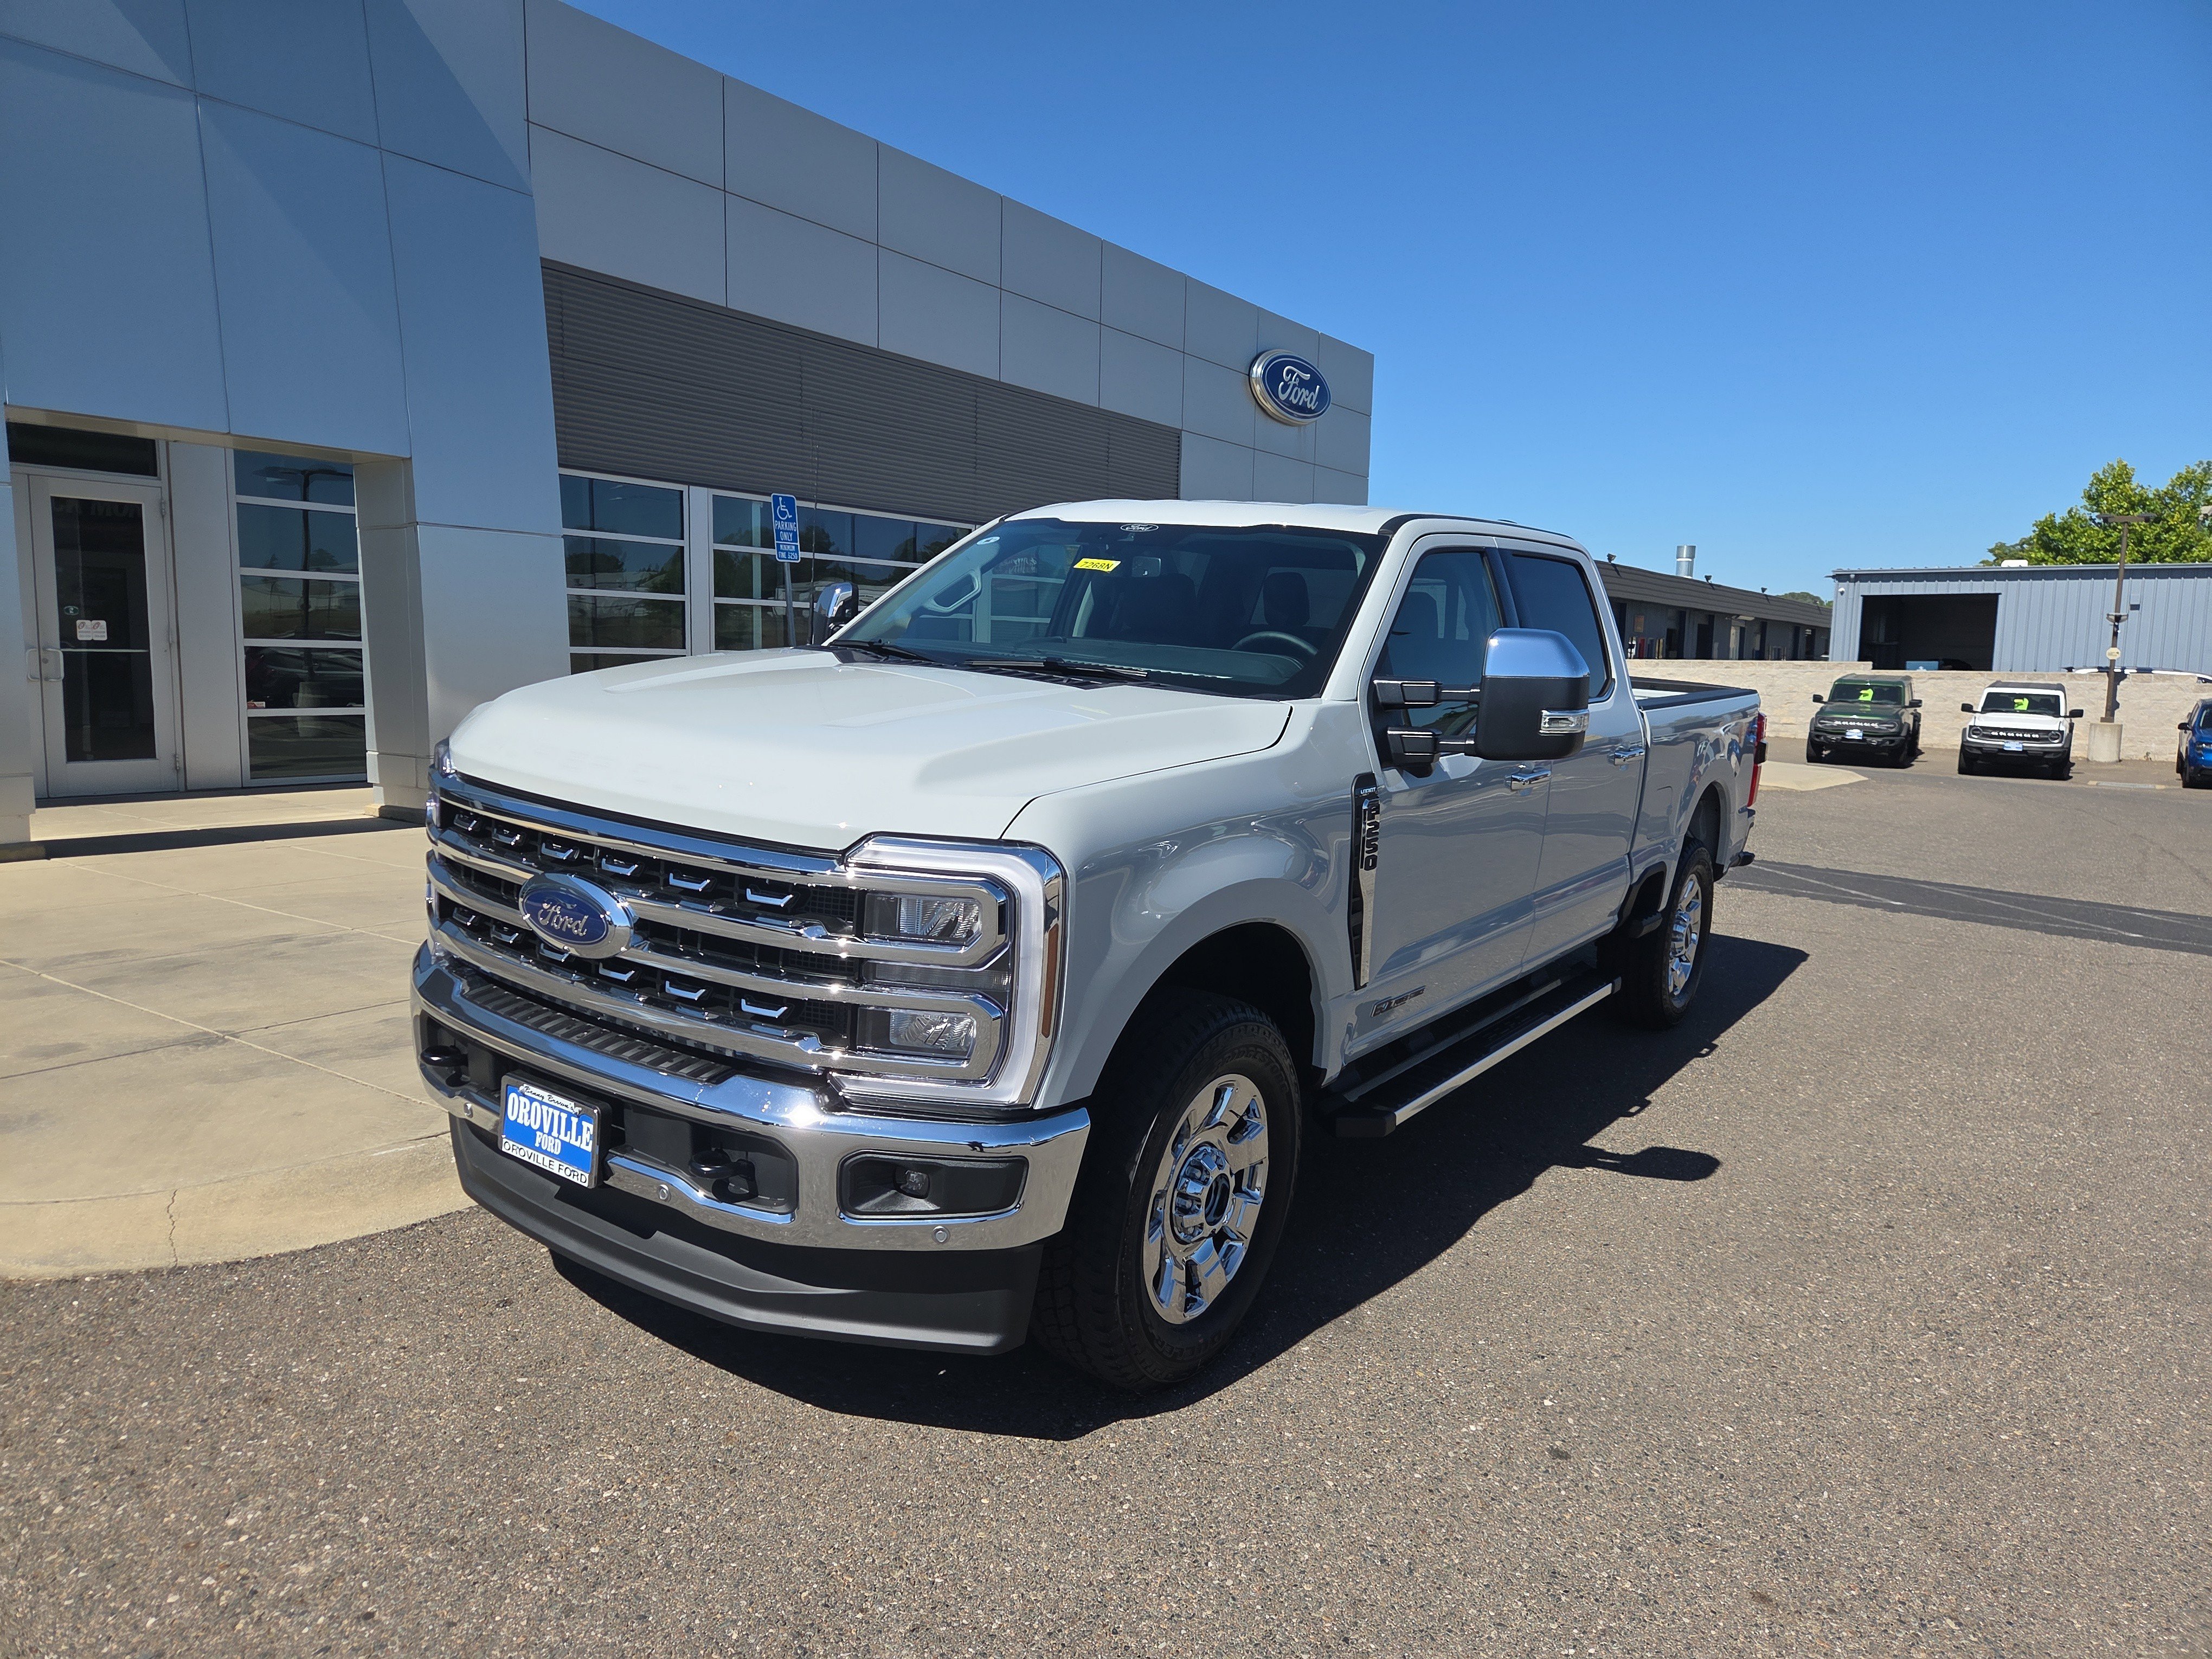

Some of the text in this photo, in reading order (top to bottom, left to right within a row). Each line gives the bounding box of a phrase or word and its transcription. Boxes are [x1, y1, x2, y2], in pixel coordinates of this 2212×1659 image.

[1278, 366, 1320, 409] Ford
[775, 520, 797, 531] PARKING
[780, 531, 793, 542] ONLY
[1080, 561, 1114, 570] 7268N
[537, 896, 589, 936] Ford
[507, 1092, 594, 1152] OROVILLE
[535, 1131, 562, 1155] FORD
[504, 1141, 587, 1184] OROVILLE FORD
